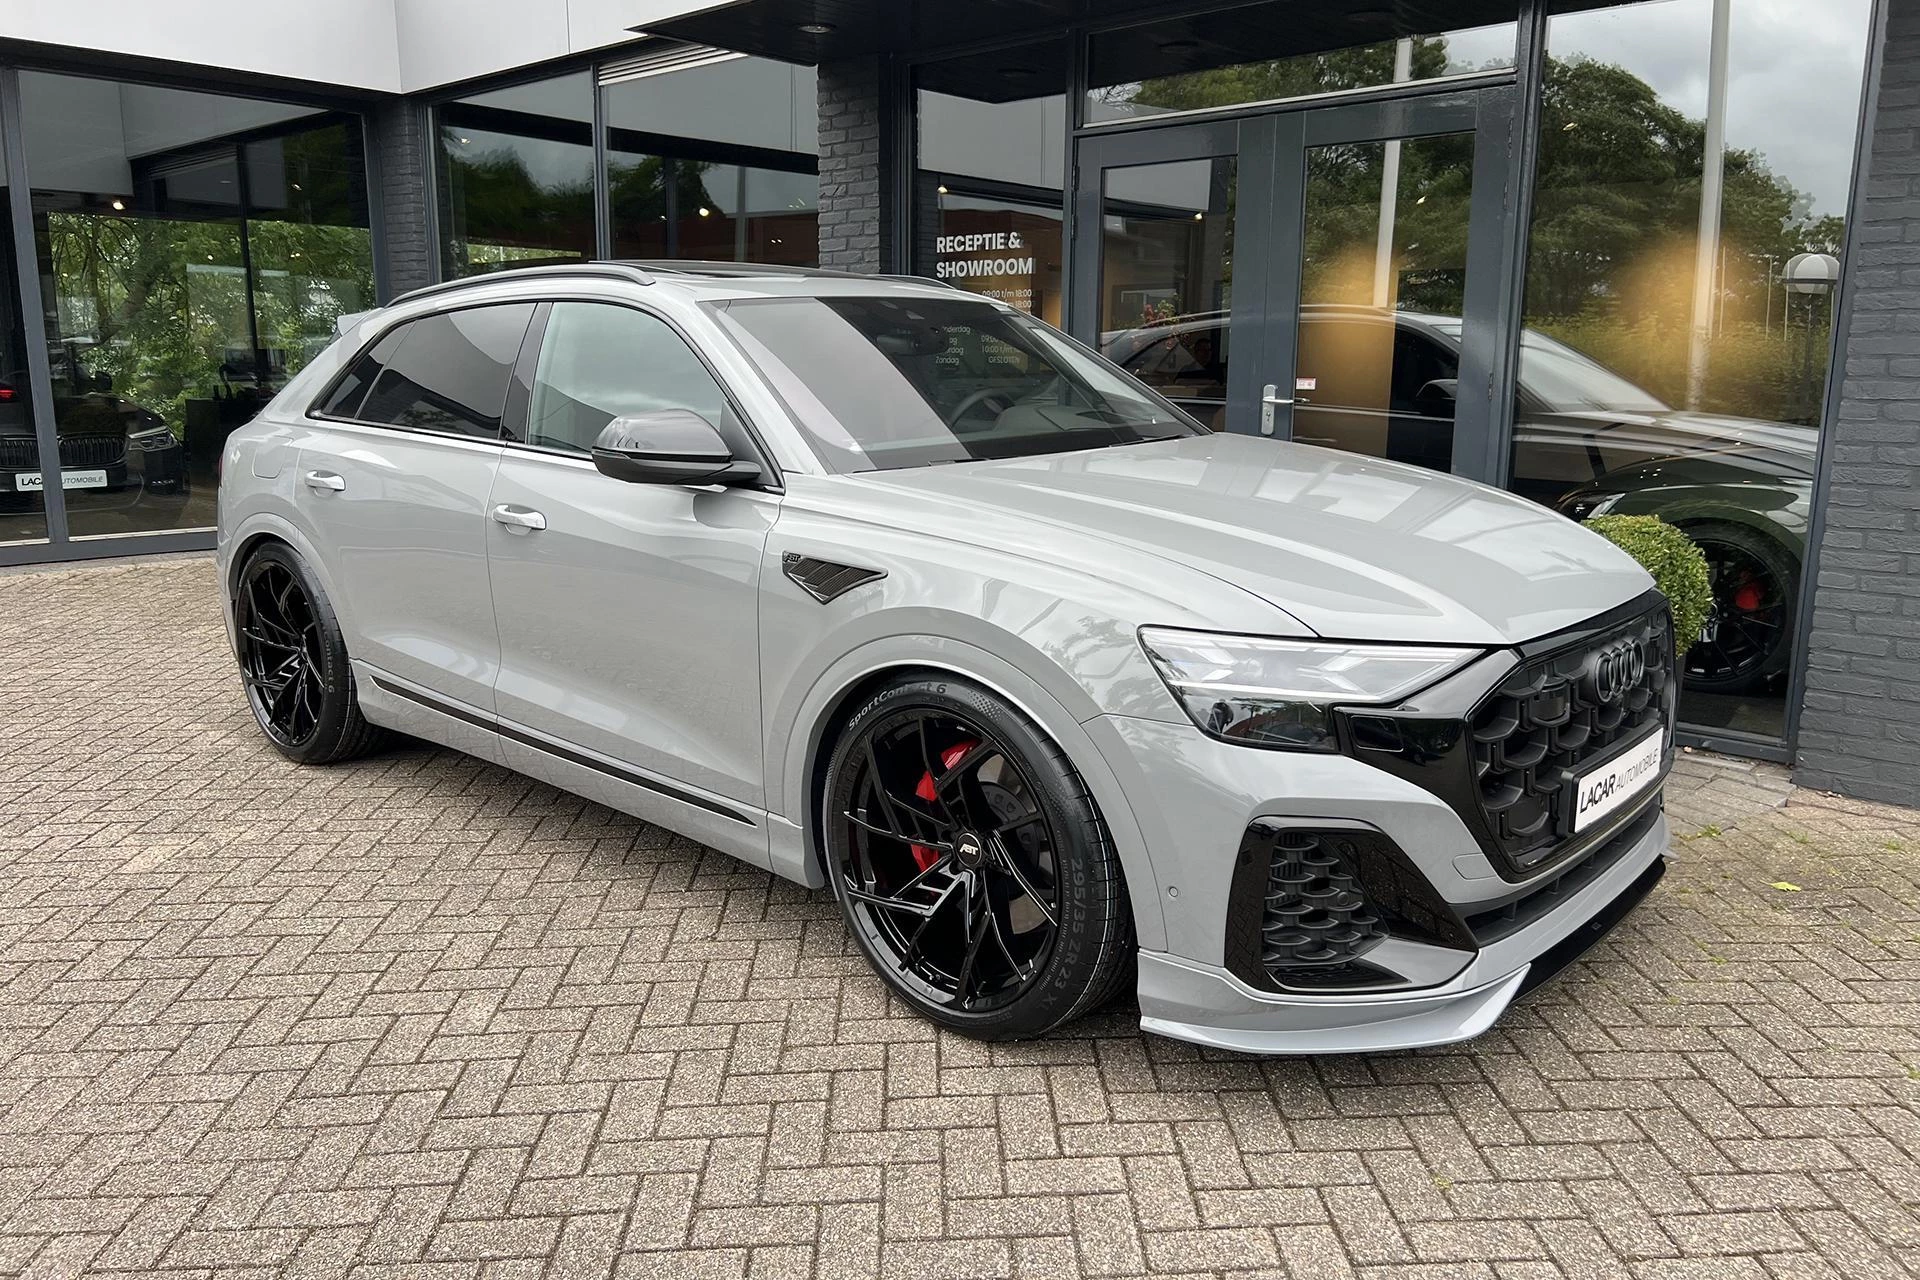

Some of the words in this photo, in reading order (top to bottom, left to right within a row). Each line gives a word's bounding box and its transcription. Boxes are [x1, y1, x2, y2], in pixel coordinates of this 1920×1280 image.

[936, 232, 1005, 254] RECEPTIE
[1008, 231, 1021, 249] &
[936, 257, 1033, 279] SHOWROOM
[1015, 288, 1032, 297] 18:00
[936, 683, 948, 694] 6
[1579, 773, 1616, 814] LACAR
[1615, 747, 1659, 792] AUTOMOBILE
[959, 843, 979, 856] ABT
[1070, 858, 1087, 934] 295/35
